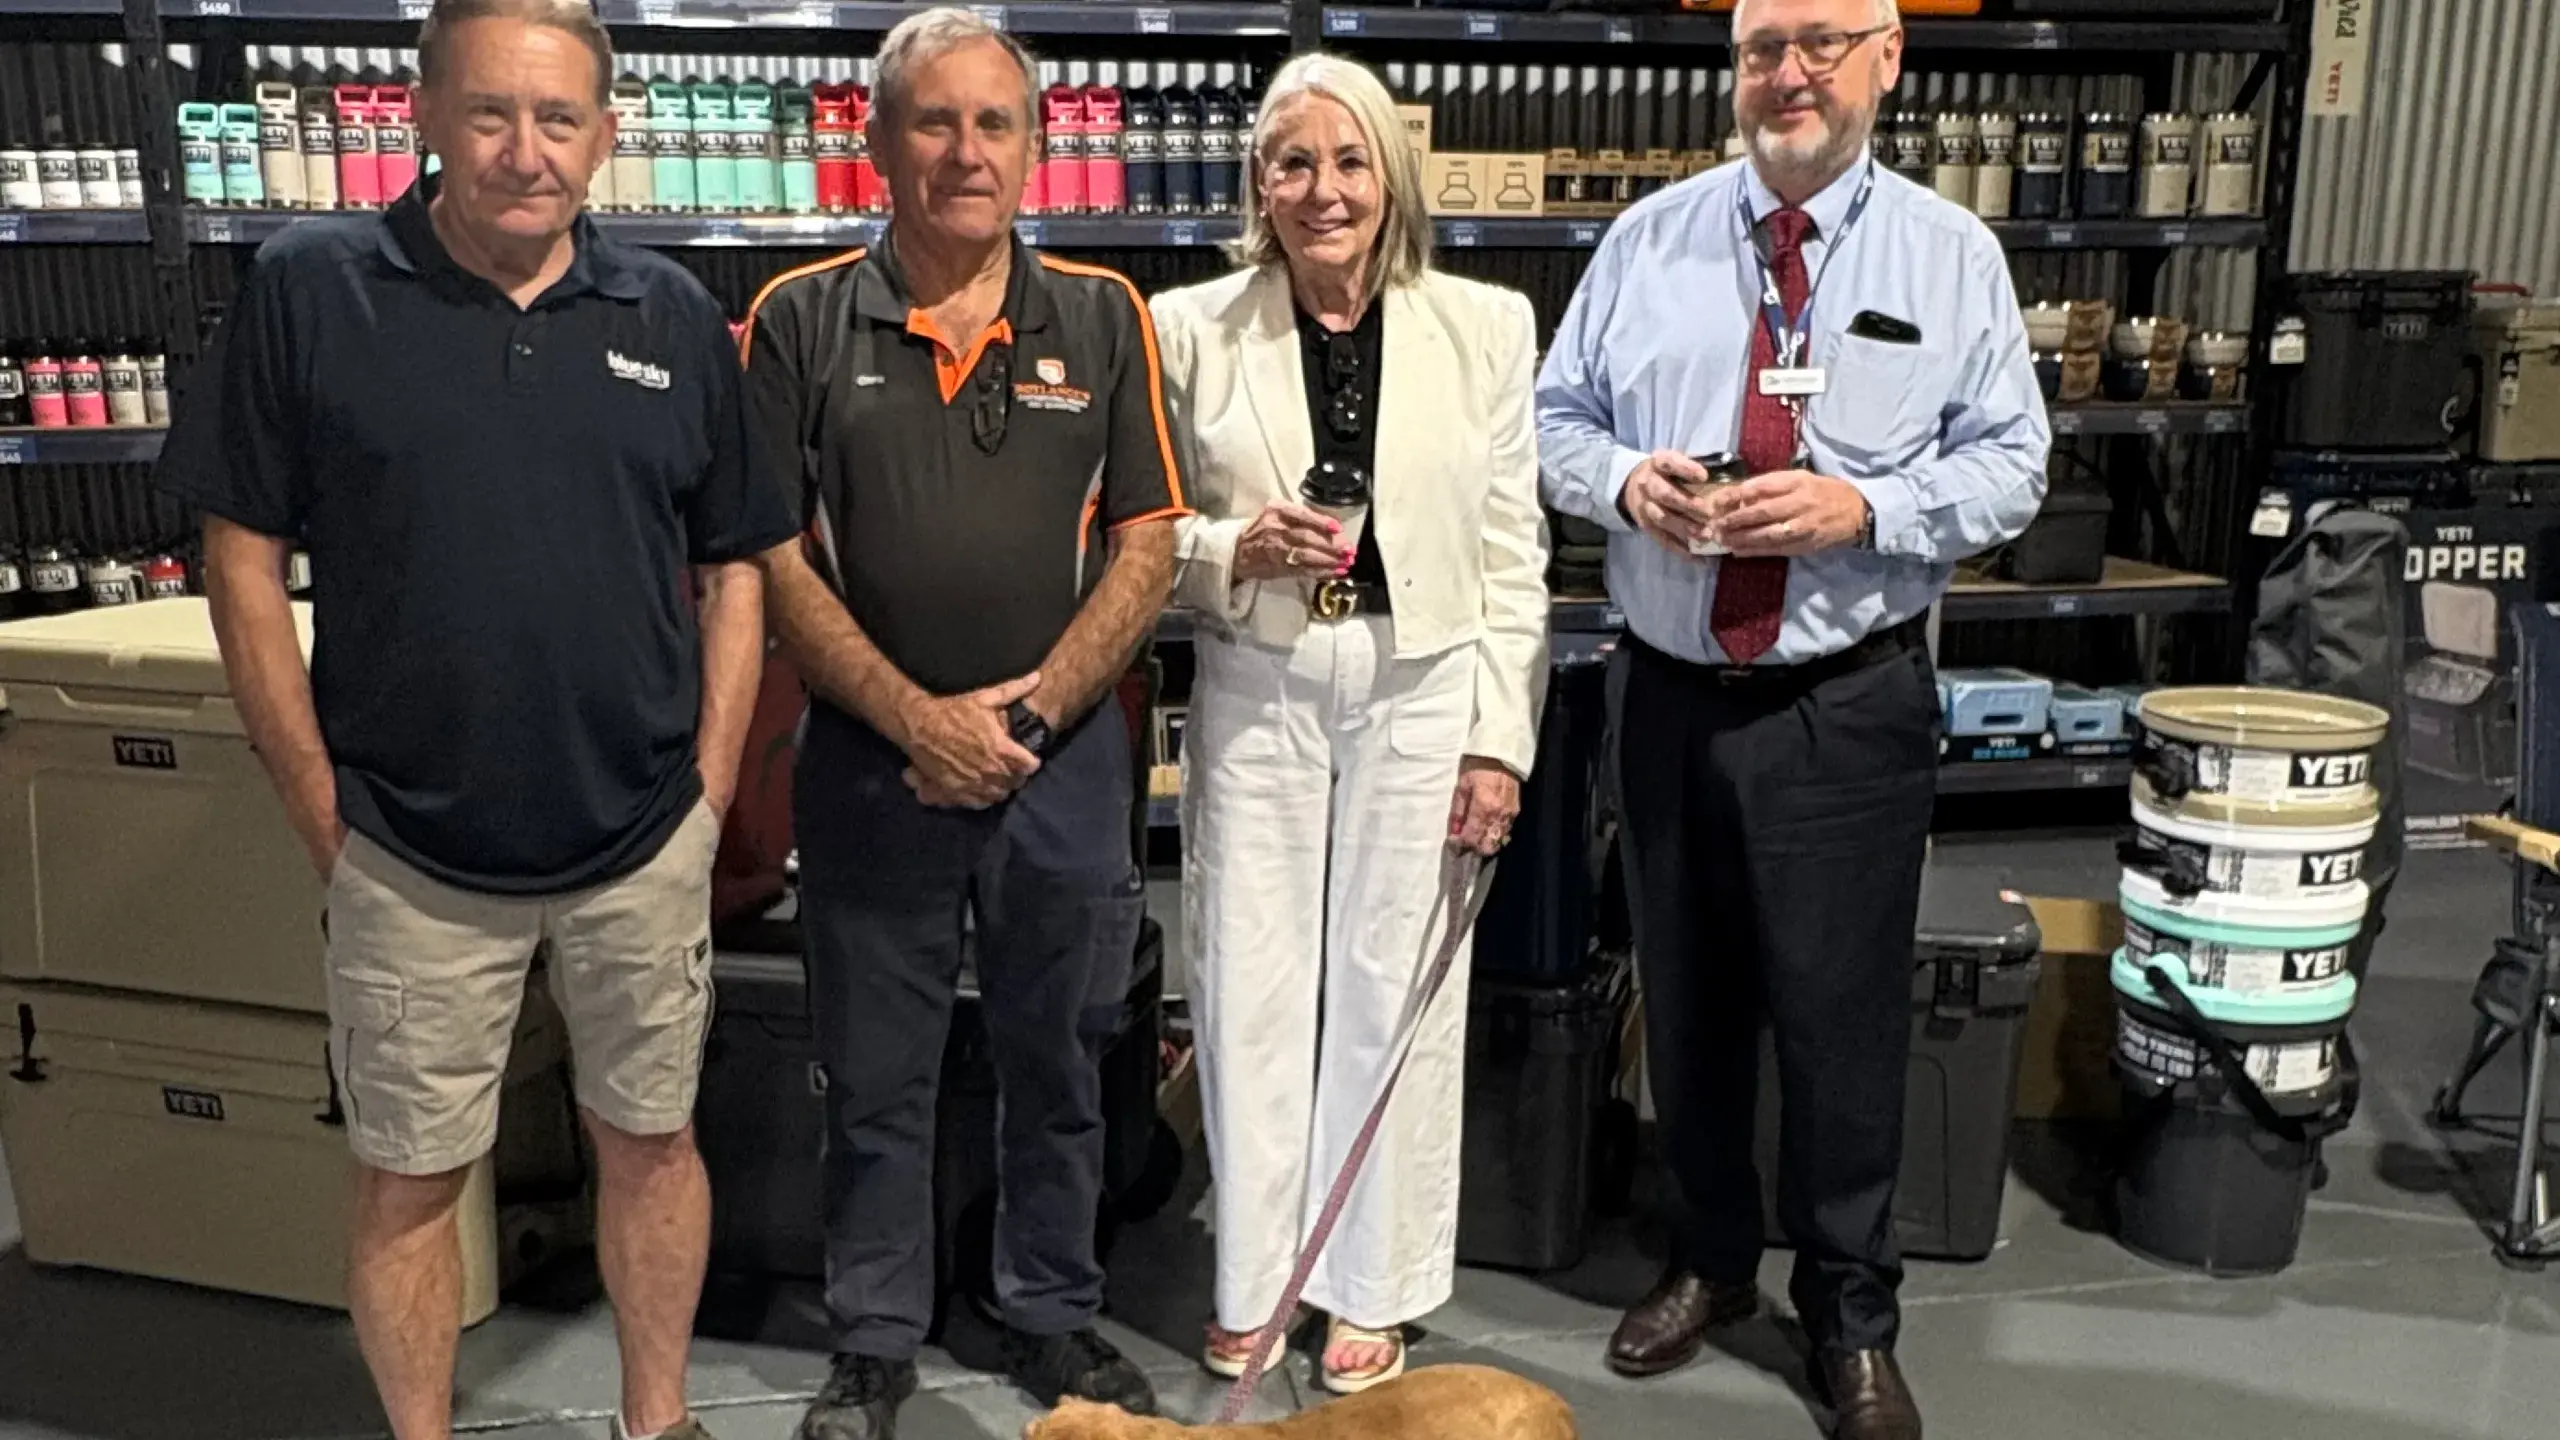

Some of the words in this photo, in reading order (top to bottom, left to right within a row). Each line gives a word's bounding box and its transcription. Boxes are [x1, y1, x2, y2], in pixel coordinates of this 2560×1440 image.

[616, 132, 647, 146] YETI
[655, 132, 687, 146] YETI
[700, 132, 731, 146] YETI
[735, 133, 764, 147] YETI
[818, 134, 848, 147] YETI
[1128, 134, 1157, 146] YETI
[1165, 133, 1194, 146] YETI
[1202, 133, 1232, 146] YETI
[2436, 527, 2473, 541] YETI
[2403, 545, 2526, 582] OPPER
[117, 742, 171, 764] YETI
[2299, 755, 2368, 785] YETI
[168, 1092, 218, 1117] YETI
